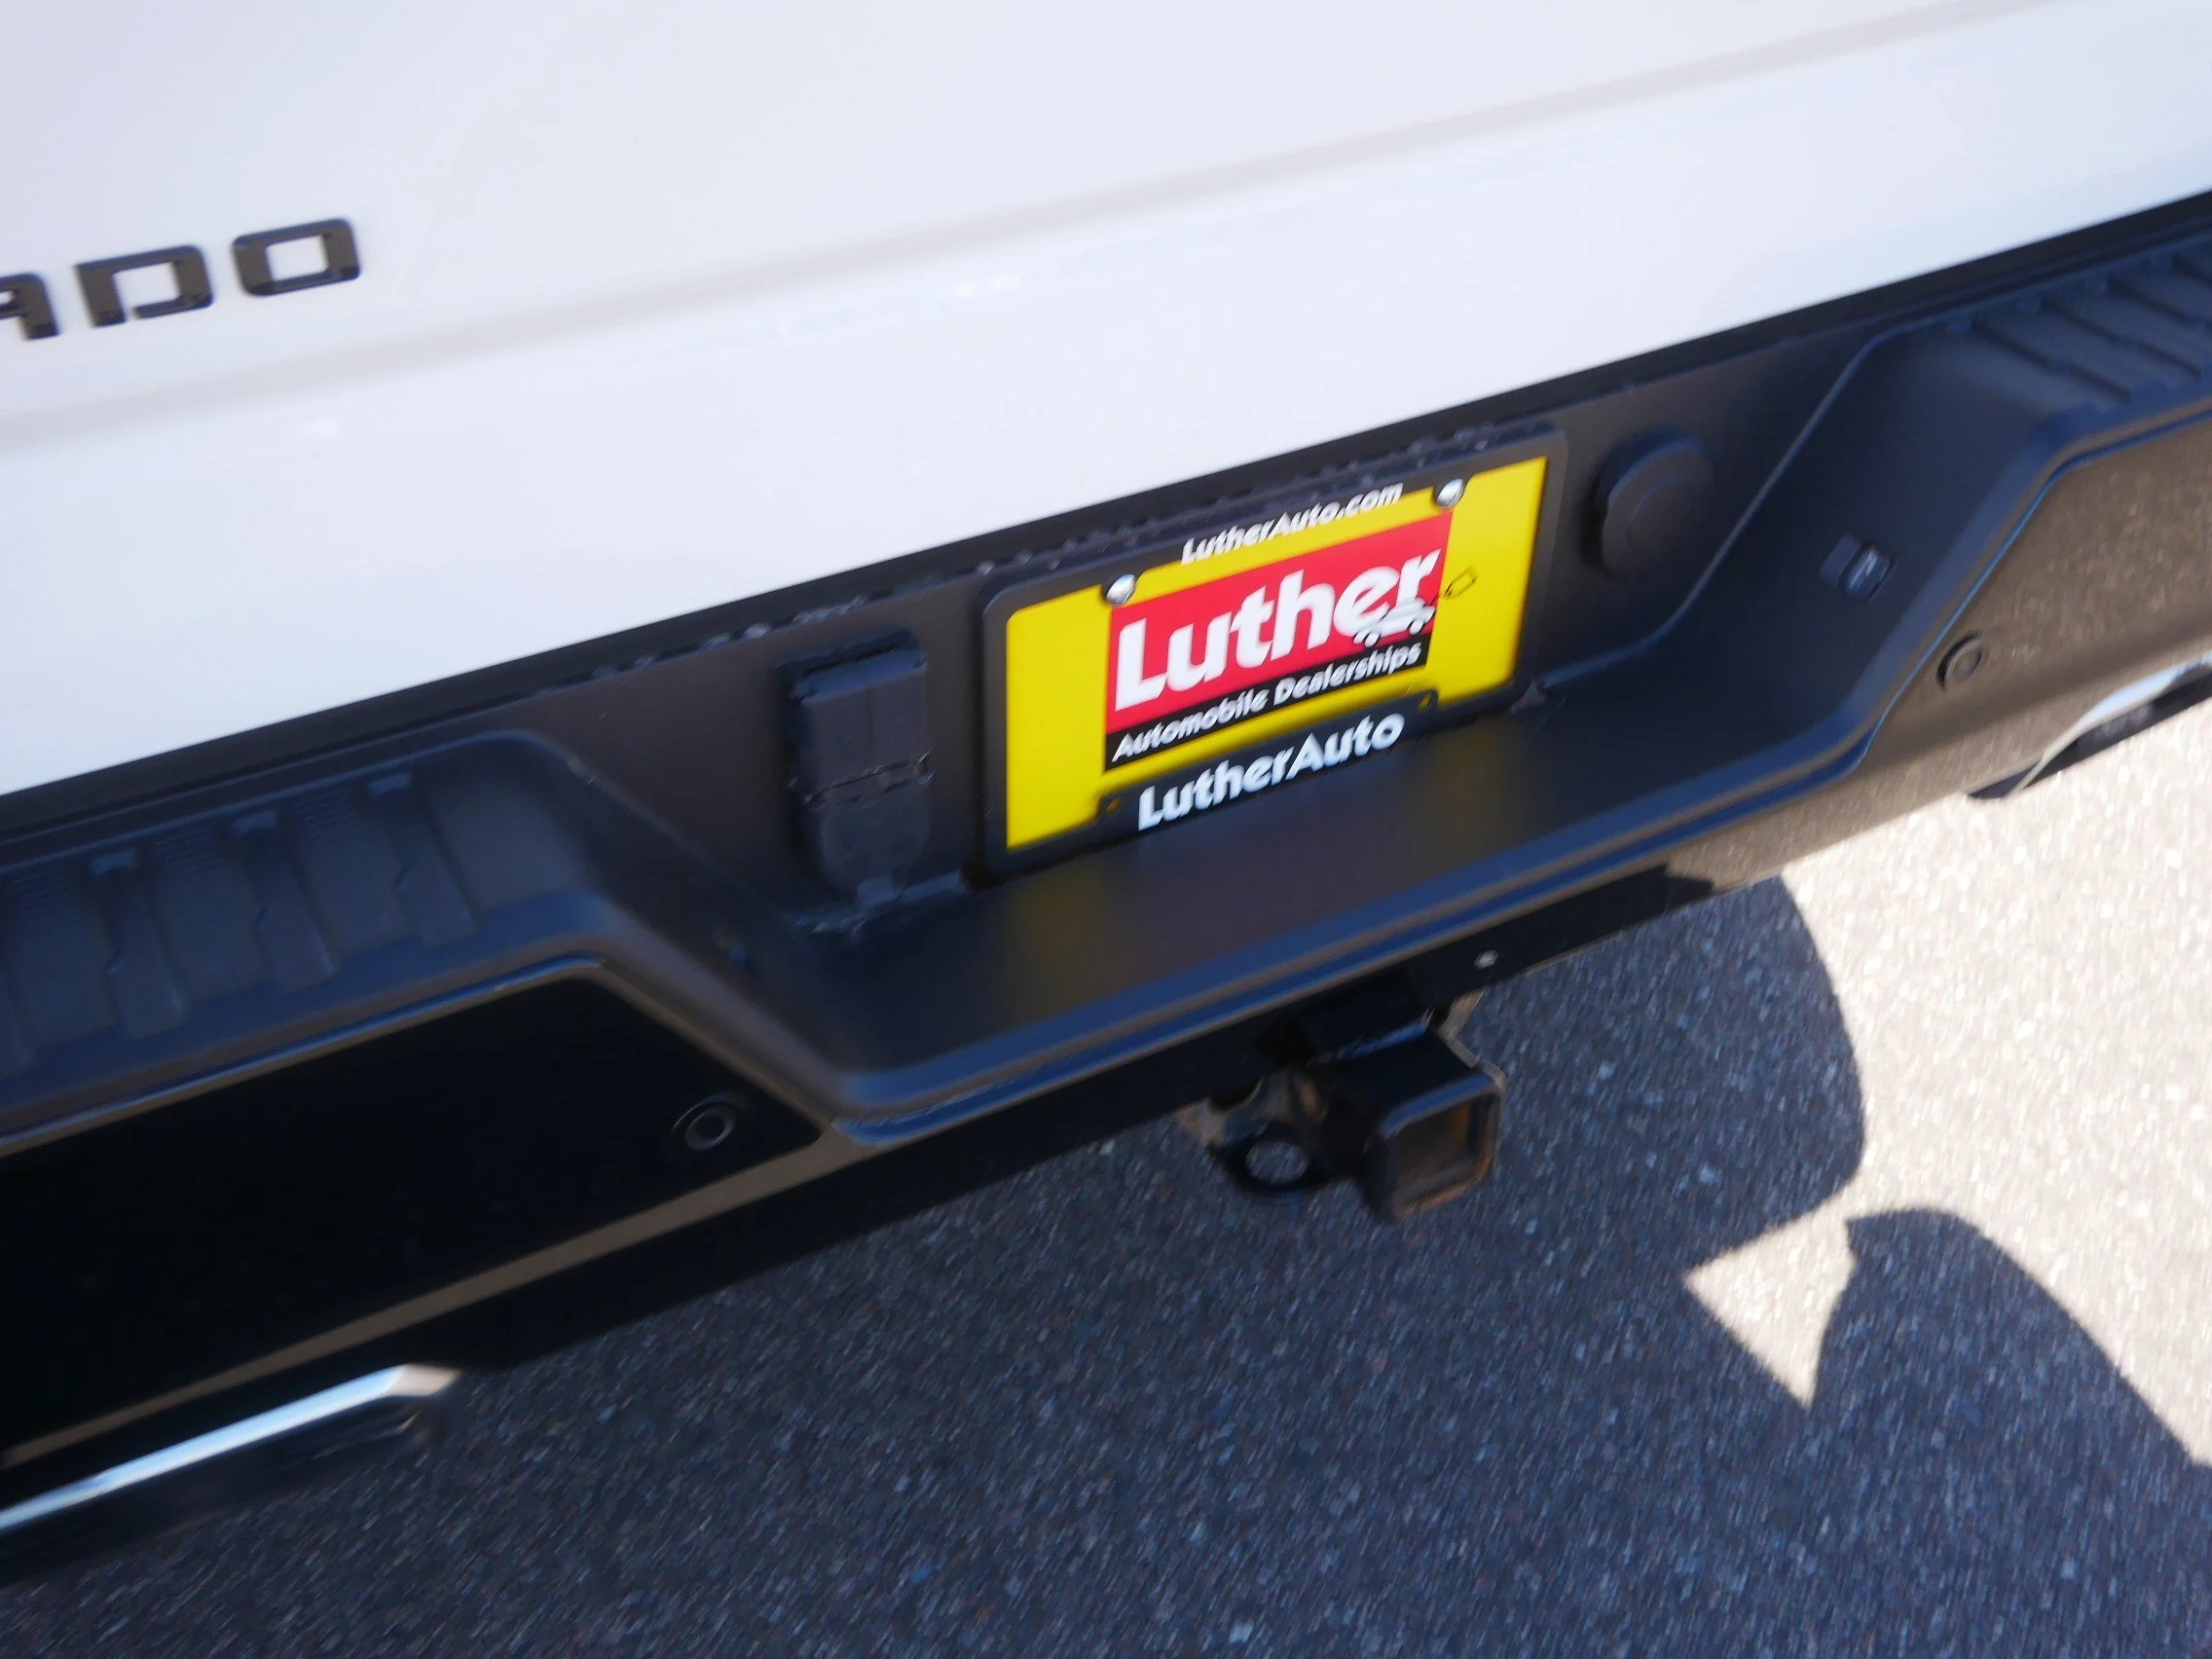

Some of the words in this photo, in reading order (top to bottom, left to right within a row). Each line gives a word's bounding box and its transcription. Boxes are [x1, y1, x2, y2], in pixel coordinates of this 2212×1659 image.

[1180, 482, 1405, 566] LutherAuto.com
[1114, 548, 1442, 713] Luther
[1111, 688, 1268, 763] Automobile
[1272, 643, 1421, 707] Dealerships
[1137, 713, 1405, 831] LutherAuto
